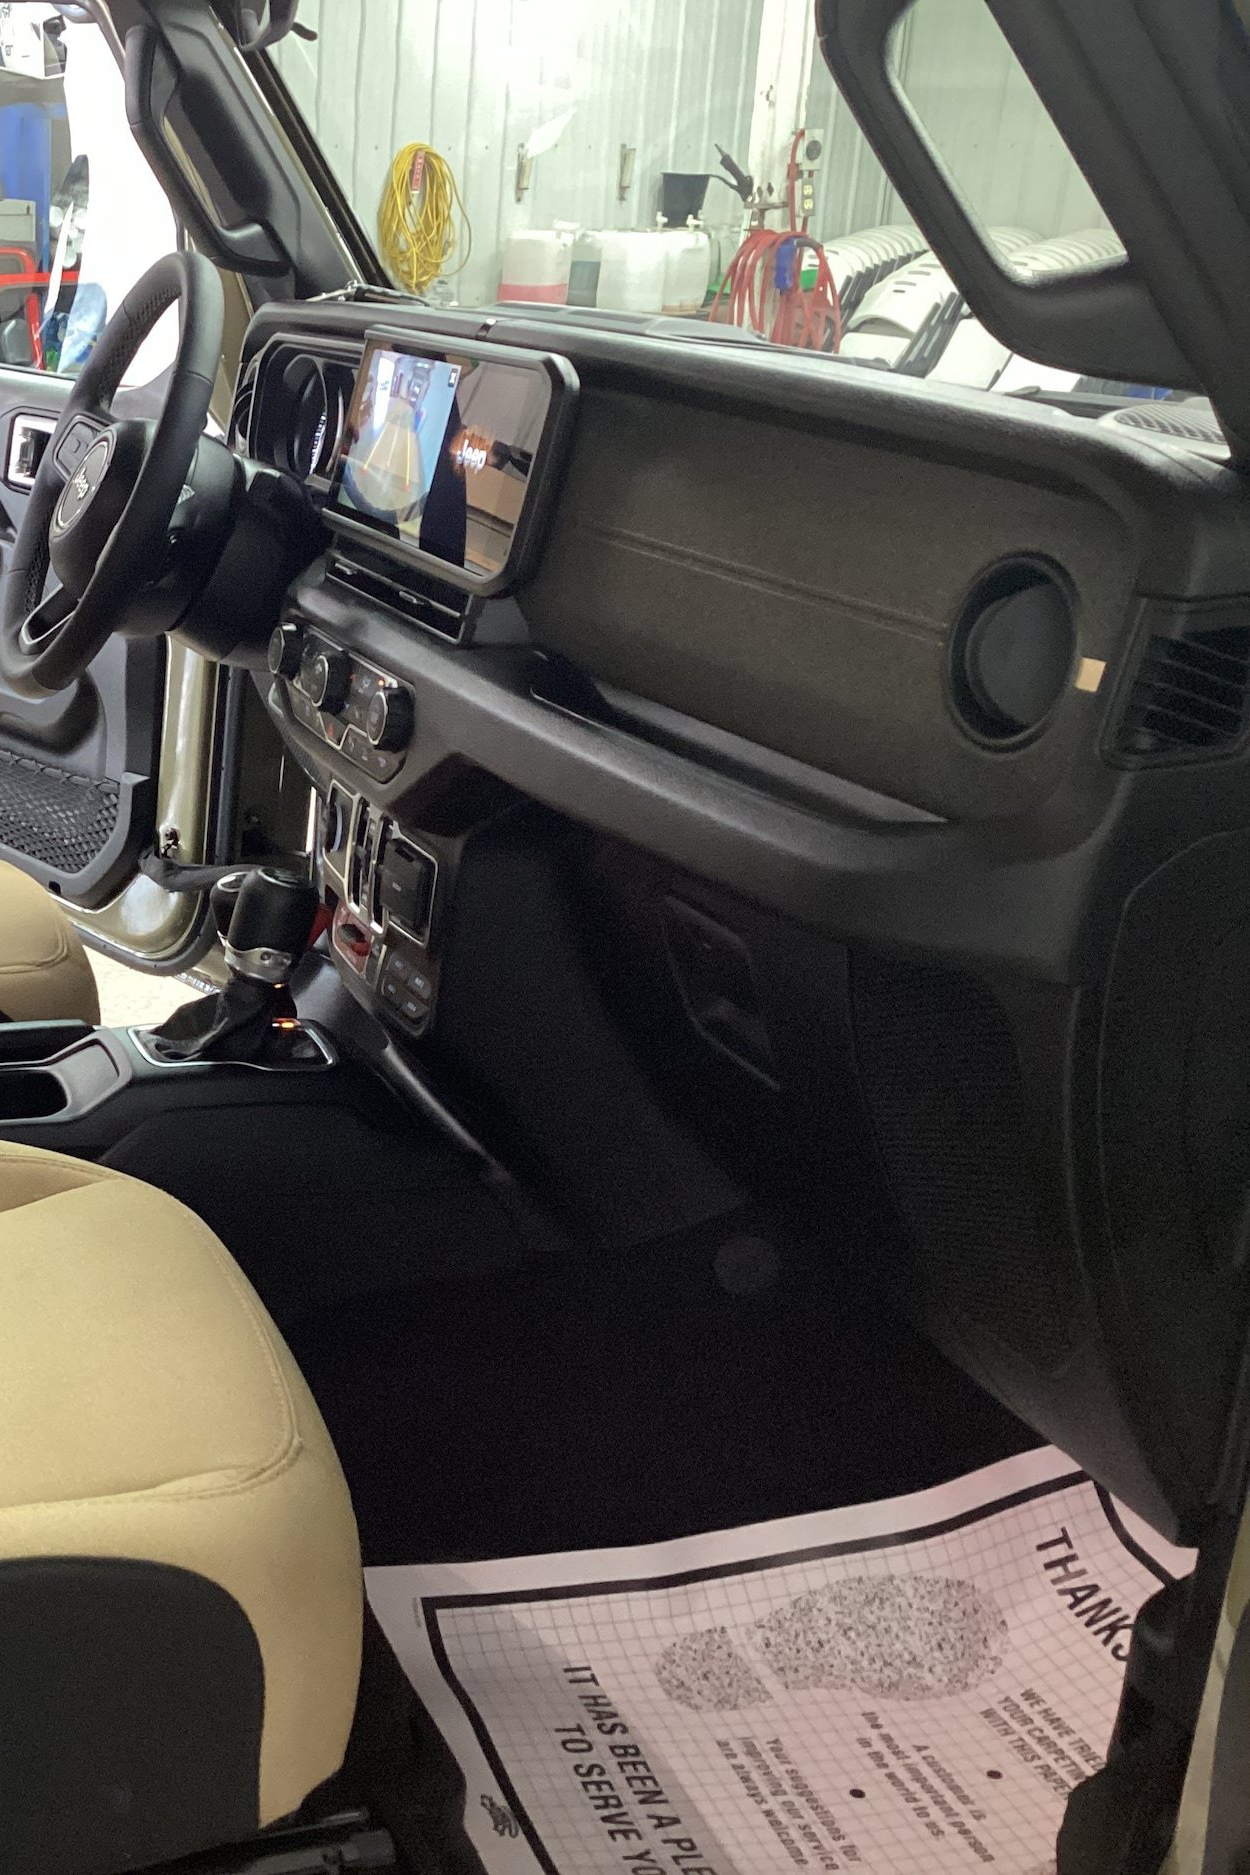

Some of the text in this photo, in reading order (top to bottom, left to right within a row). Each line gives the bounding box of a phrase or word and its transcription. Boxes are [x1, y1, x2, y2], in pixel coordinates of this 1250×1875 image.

[455, 439, 487, 474] Jeep
[564, 1666, 599, 1686] IT
[554, 1723, 593, 1753] TO
[578, 1695, 628, 1735] HAS
[980, 1708, 1015, 1737] WITH
[1009, 1737, 1041, 1762] THIS
[998, 1696, 1086, 1780] YOUR CARPETIN
[1020, 1688, 1047, 1708] WE
[1037, 1707, 1076, 1738] HAVE
[573, 1763, 643, 1842] SERVE
[608, 1744, 669, 1804] BEEN
[716, 1740, 737, 1760] are
[732, 1764, 768, 1805] always
[766, 1738, 862, 1861] Your suggestions for
[856, 1738, 872, 1748] in
[868, 1751, 889, 1769] the
[885, 1772, 921, 1803] world
[912, 1806, 930, 1818] to
[861, 1712, 995, 1862] the most important person
[922, 1755, 975, 1805] customer
[969, 1810, 987, 1821] is
[647, 1814, 681, 1829] A
[781, 1800, 804, 1819] our
[798, 1824, 839, 1870] service
